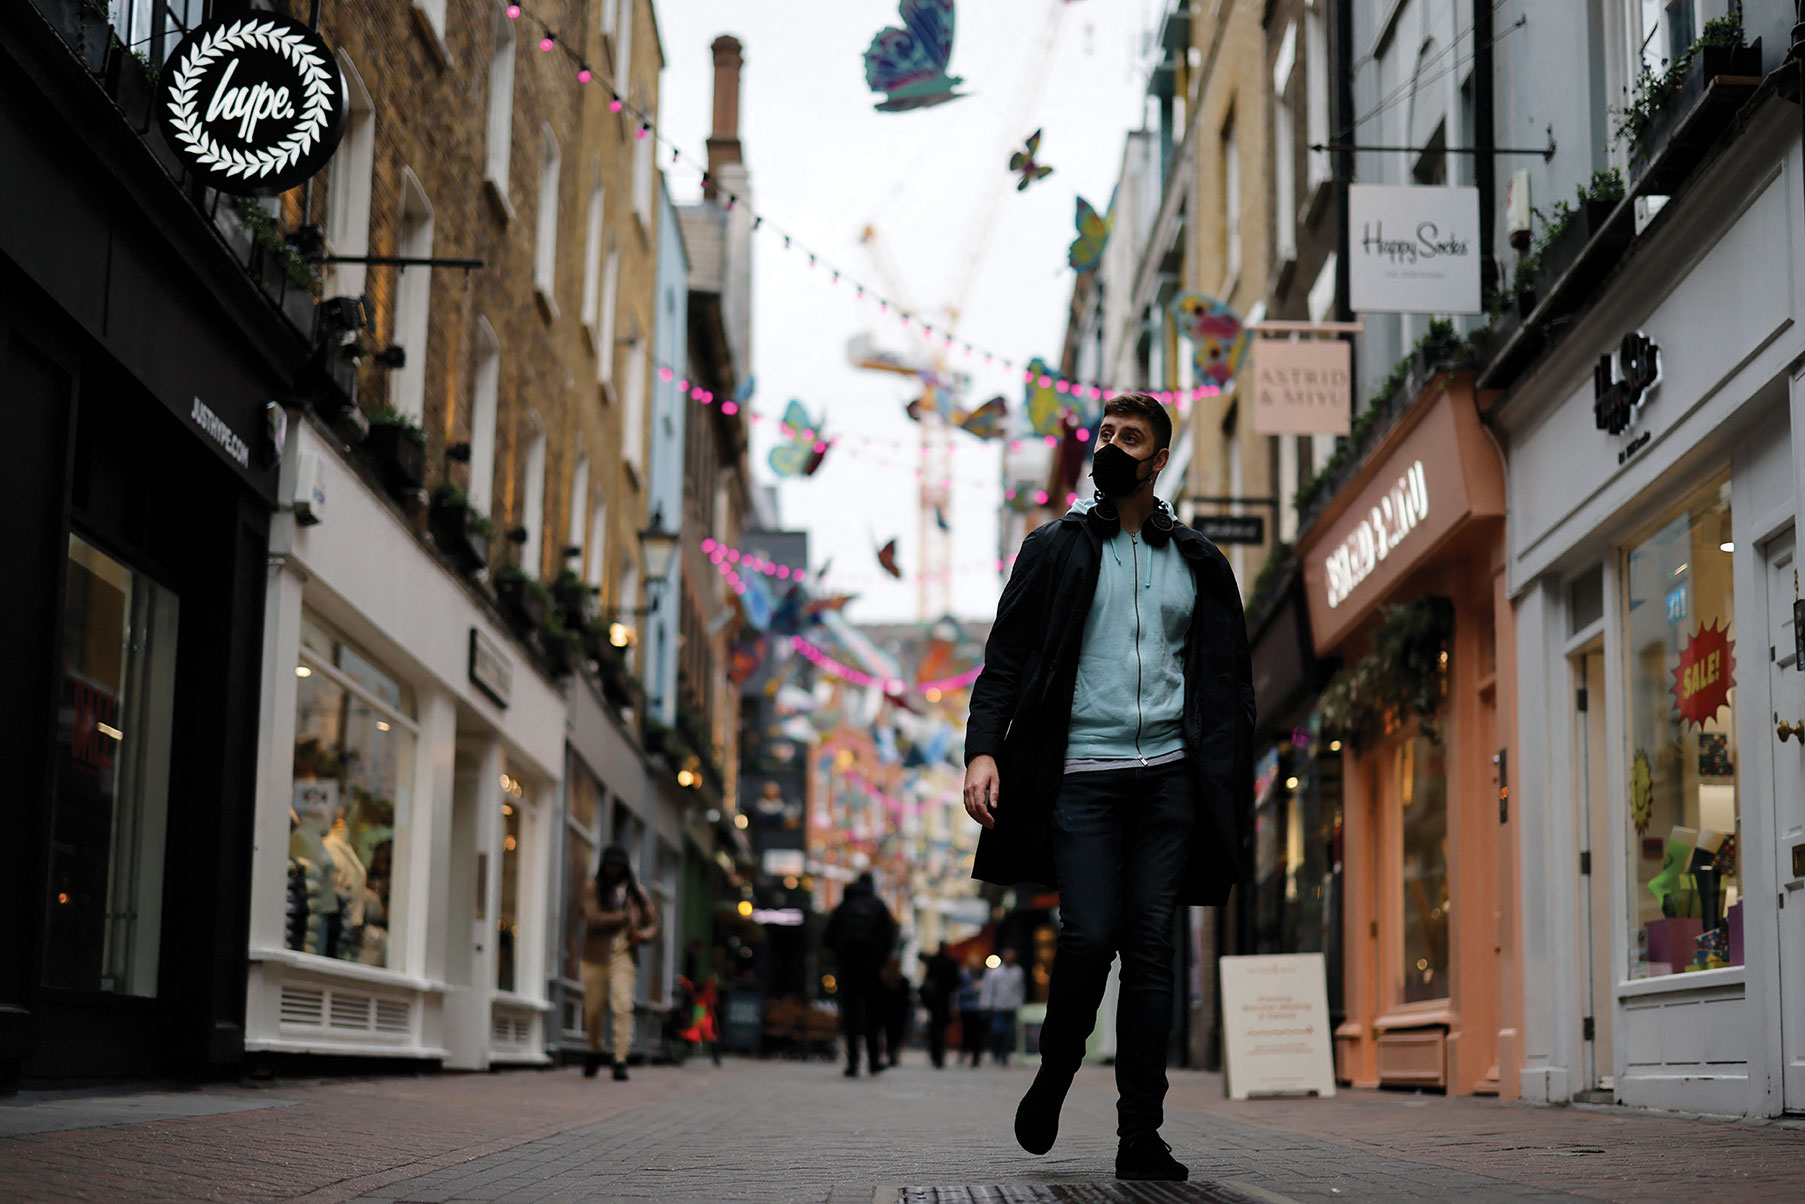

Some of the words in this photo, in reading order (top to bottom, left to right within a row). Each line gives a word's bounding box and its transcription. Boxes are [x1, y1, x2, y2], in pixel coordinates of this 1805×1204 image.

[205, 57, 295, 143] hype.
[1360, 219, 1418, 265] Happy
[1416, 220, 1468, 258] Socks
[1260, 368, 1347, 387] ASTRID
[1260, 388, 1275, 407] &
[1683, 649, 1720, 699] SALE!
